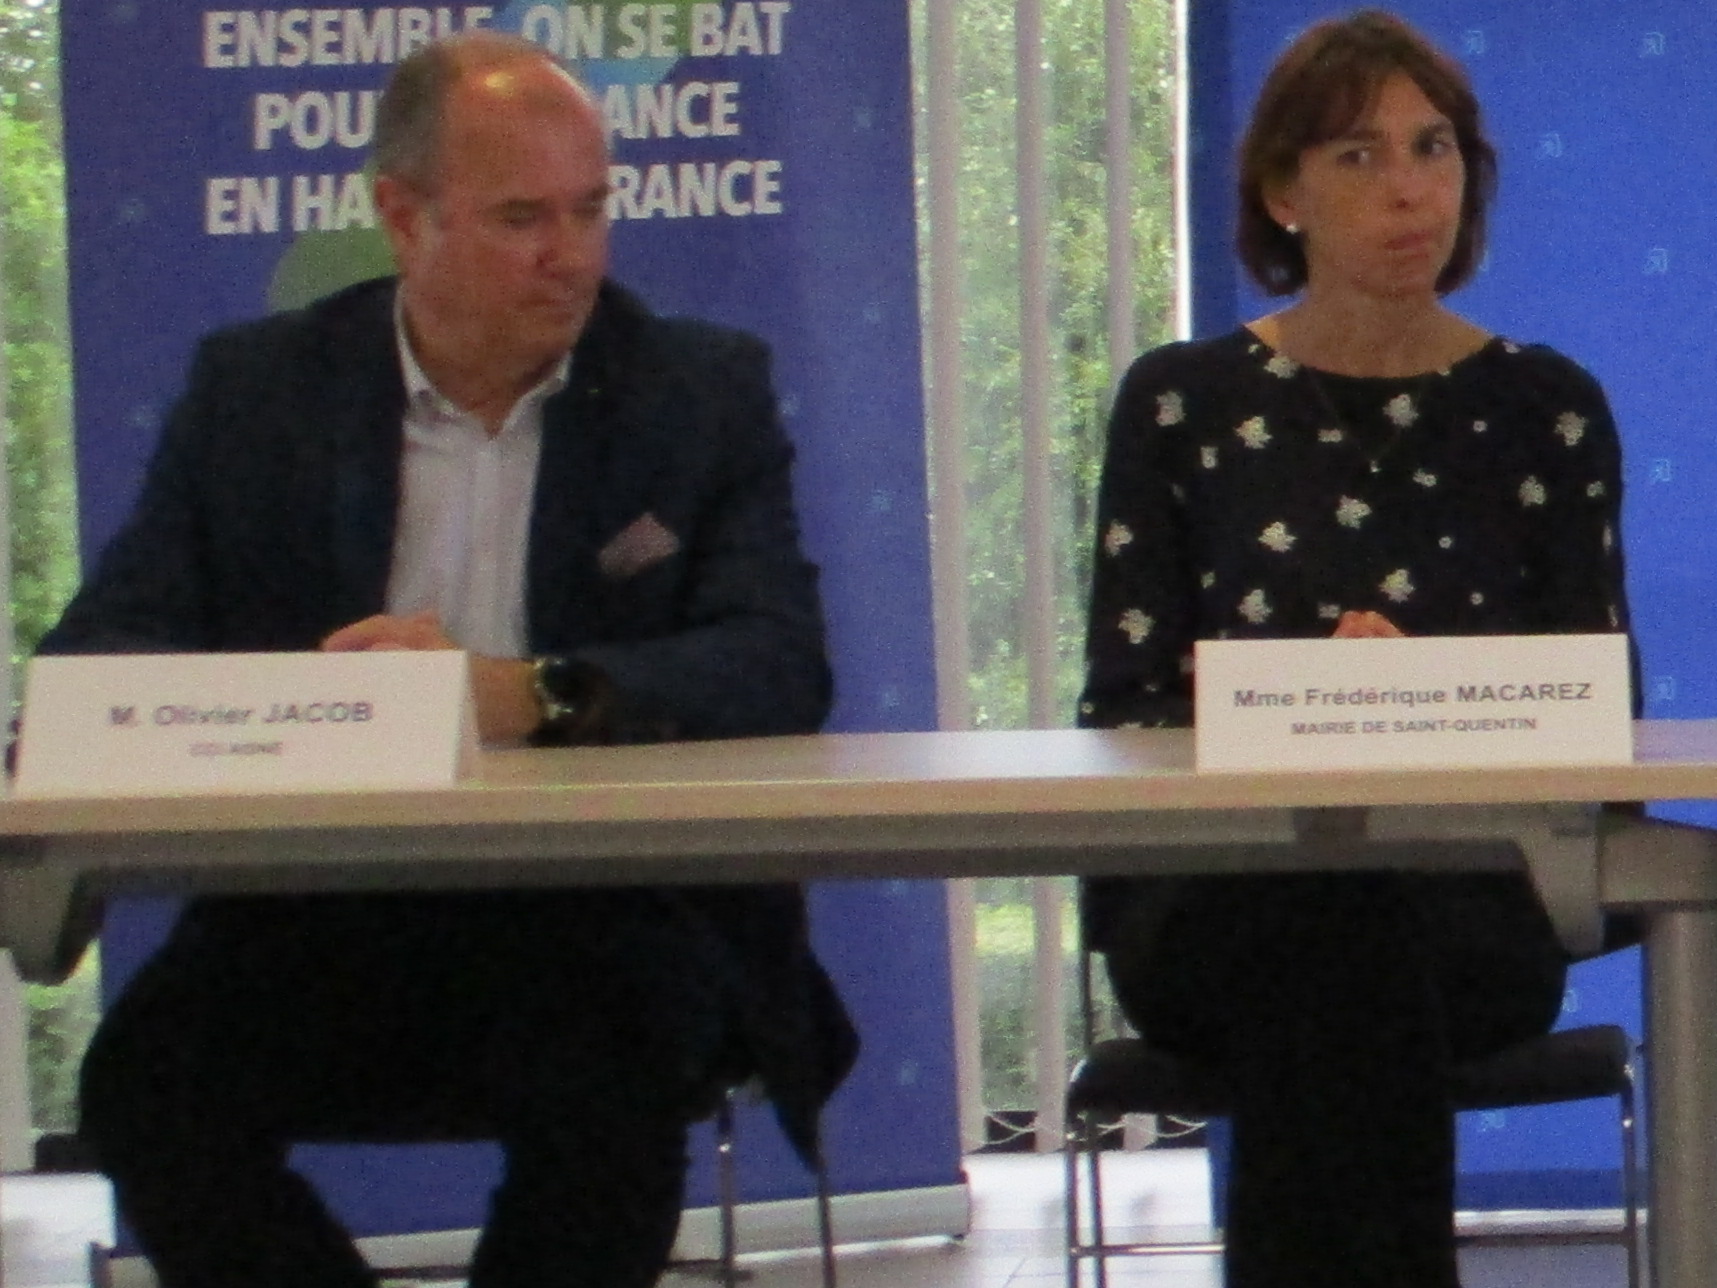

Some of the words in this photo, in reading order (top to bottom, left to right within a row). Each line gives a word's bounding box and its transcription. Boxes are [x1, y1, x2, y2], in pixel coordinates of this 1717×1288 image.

[522, 5, 602, 59] ON
[614, 3, 679, 59] SE
[690, 1, 791, 57] BAT
[253, 91, 383, 151] POU
[604, 81, 740, 139] ANCE
[205, 176, 279, 235] EN
[261, 701, 374, 724] JACOB
[1233, 689, 1295, 708] Mme
[1304, 687, 1446, 710] Frédérique
[1456, 682, 1592, 702] MACAREZ
[1290, 721, 1355, 736] MAIRIE
[1361, 720, 1388, 734] DE
[1393, 717, 1537, 734] SAINT-QUENTIN
